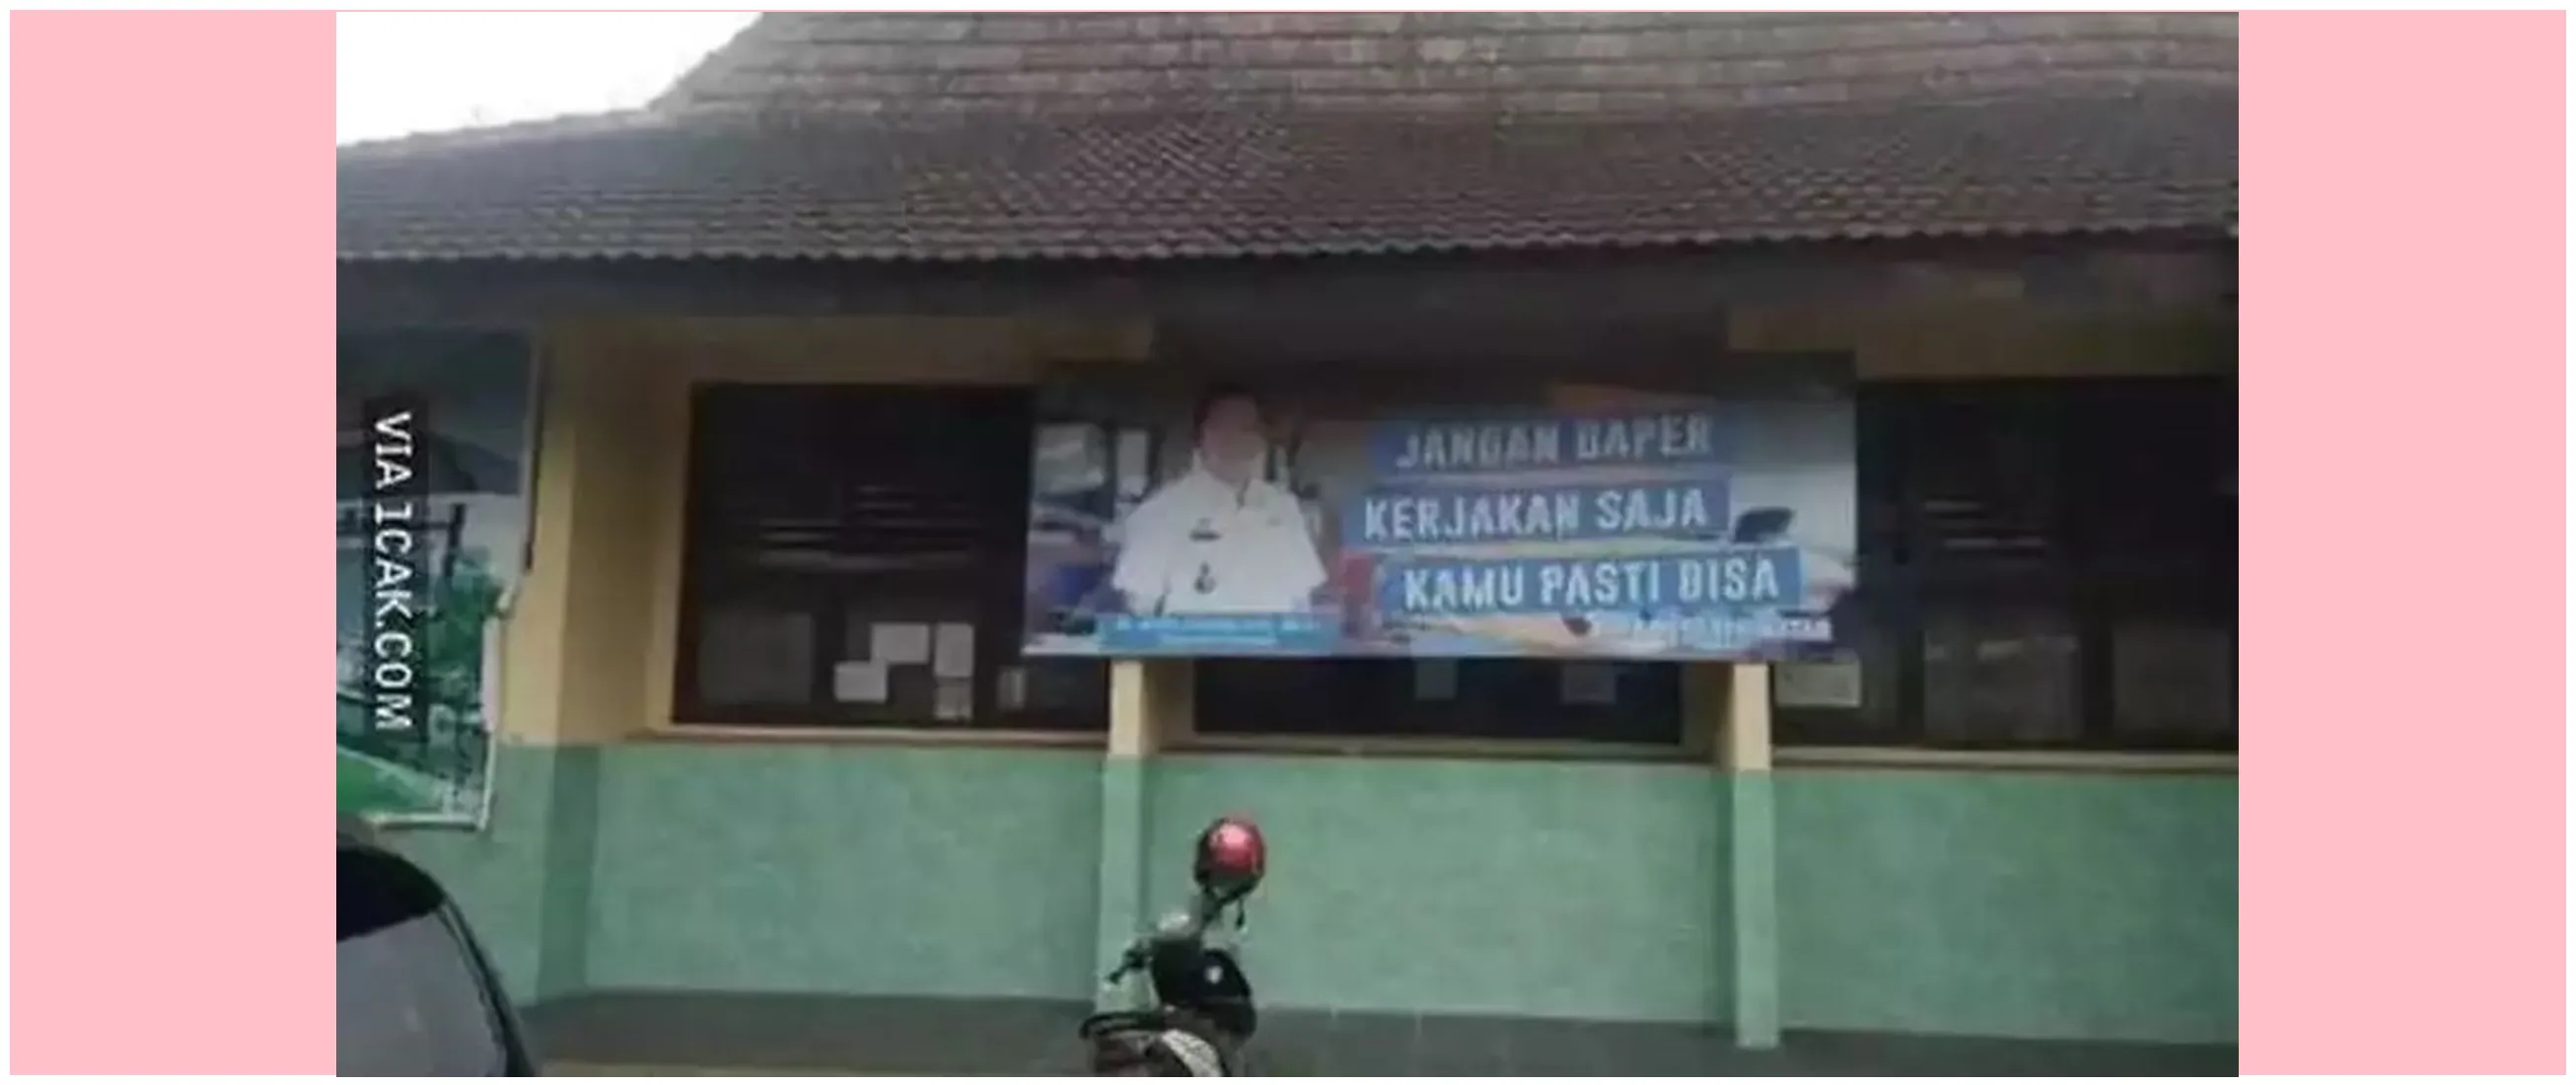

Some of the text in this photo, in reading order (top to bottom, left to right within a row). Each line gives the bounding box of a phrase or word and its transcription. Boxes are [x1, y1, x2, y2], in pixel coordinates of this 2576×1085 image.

[1396, 413, 1714, 469] JANGAN BAPER
[1365, 488, 1707, 542] KERJAKAN SAJA
[1403, 556, 1779, 612] KAMU PASTI BISA
